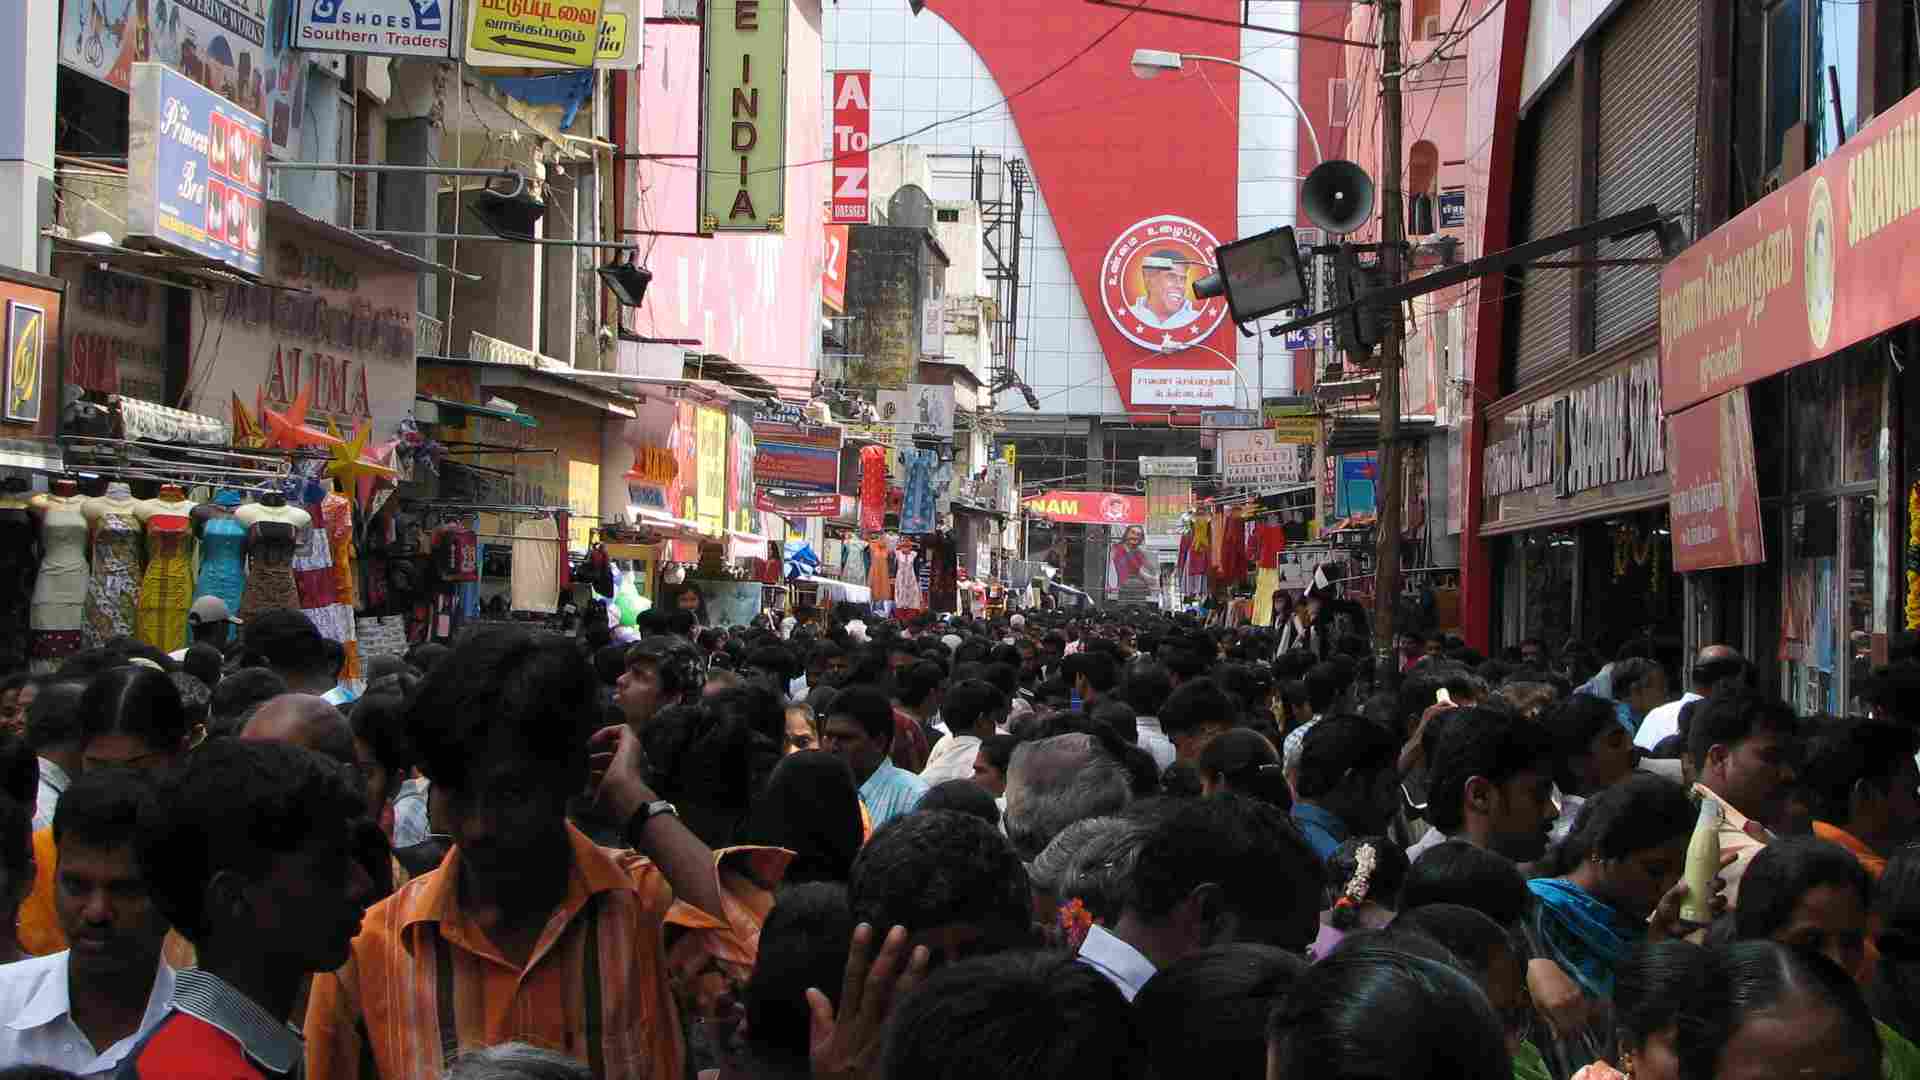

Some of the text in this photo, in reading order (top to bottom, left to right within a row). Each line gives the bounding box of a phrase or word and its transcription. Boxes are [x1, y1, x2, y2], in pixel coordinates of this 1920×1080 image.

[302, 26, 448, 49] Southern Traders
[342, 12, 411, 29] SHOES
[728, 54, 758, 221] INDIA
[835, 74, 869, 198] A To Z
